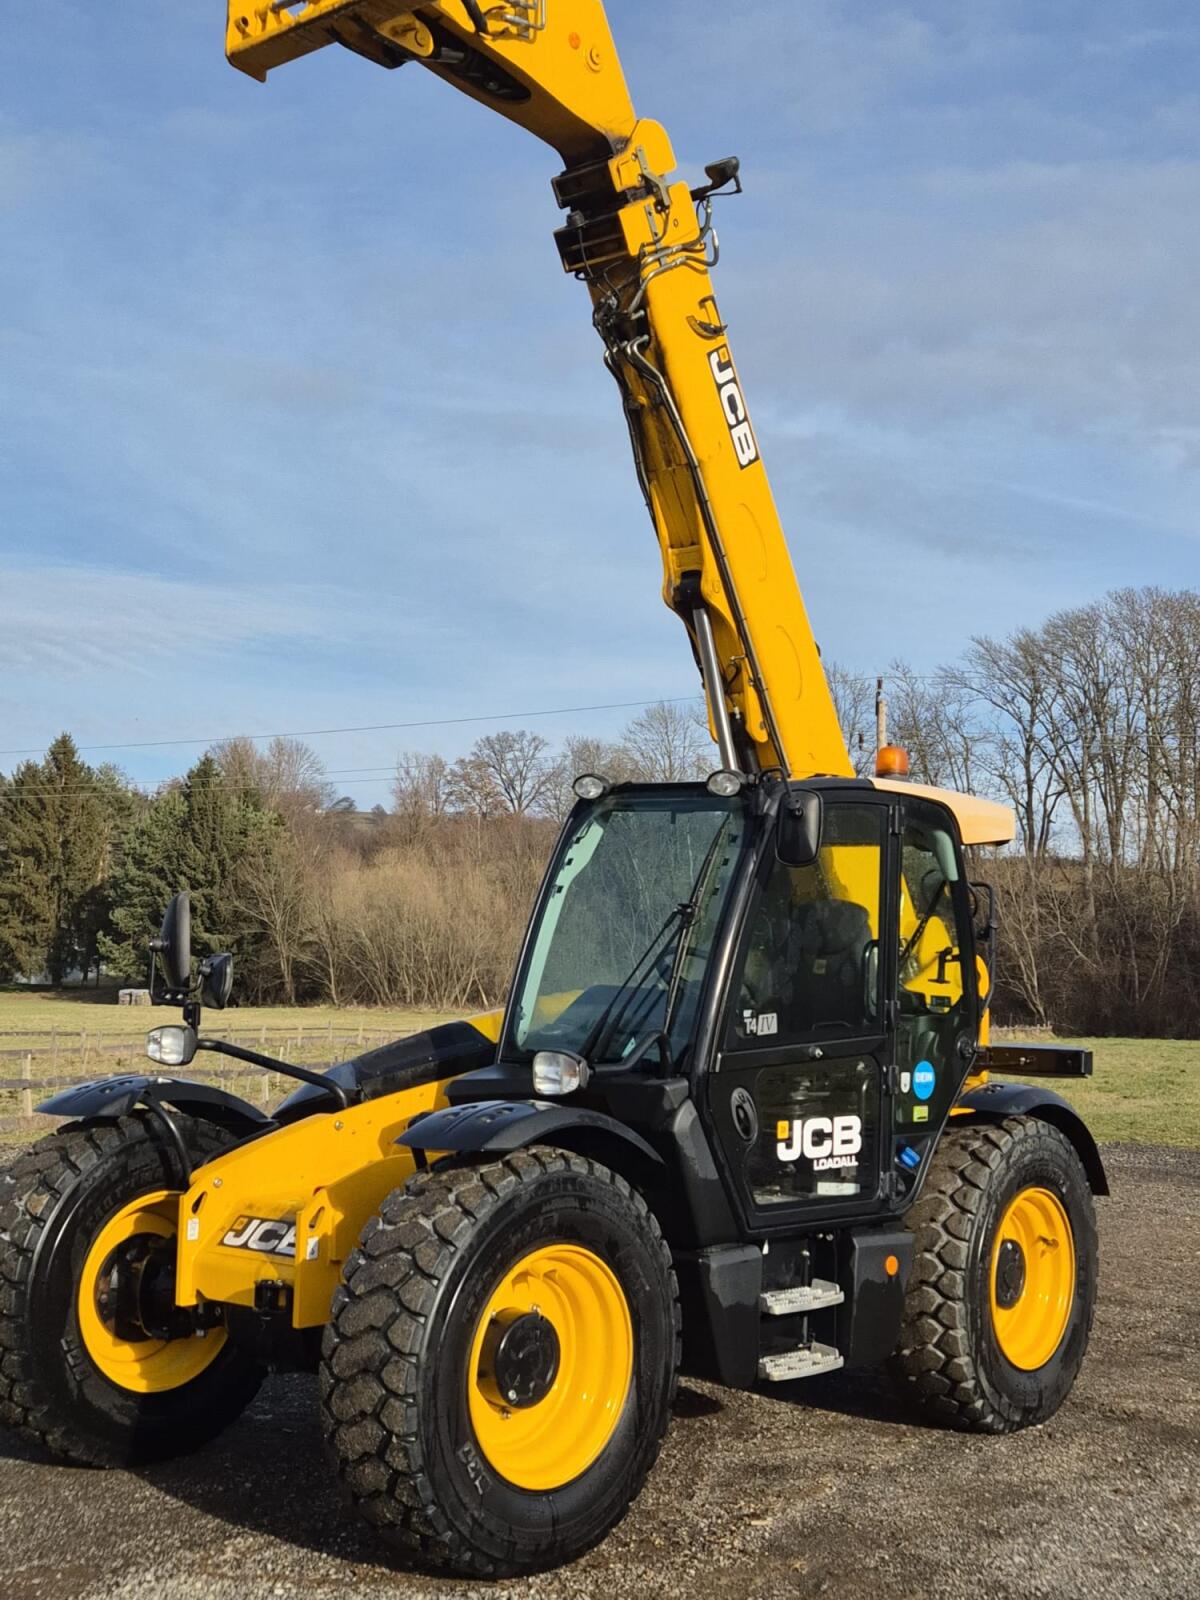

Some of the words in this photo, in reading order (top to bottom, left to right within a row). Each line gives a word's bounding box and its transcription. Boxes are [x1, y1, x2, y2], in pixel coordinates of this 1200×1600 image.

[709, 346, 757, 466] JCB
[777, 1115, 862, 1162] JCB
[813, 1155, 859, 1171] LOADALL
